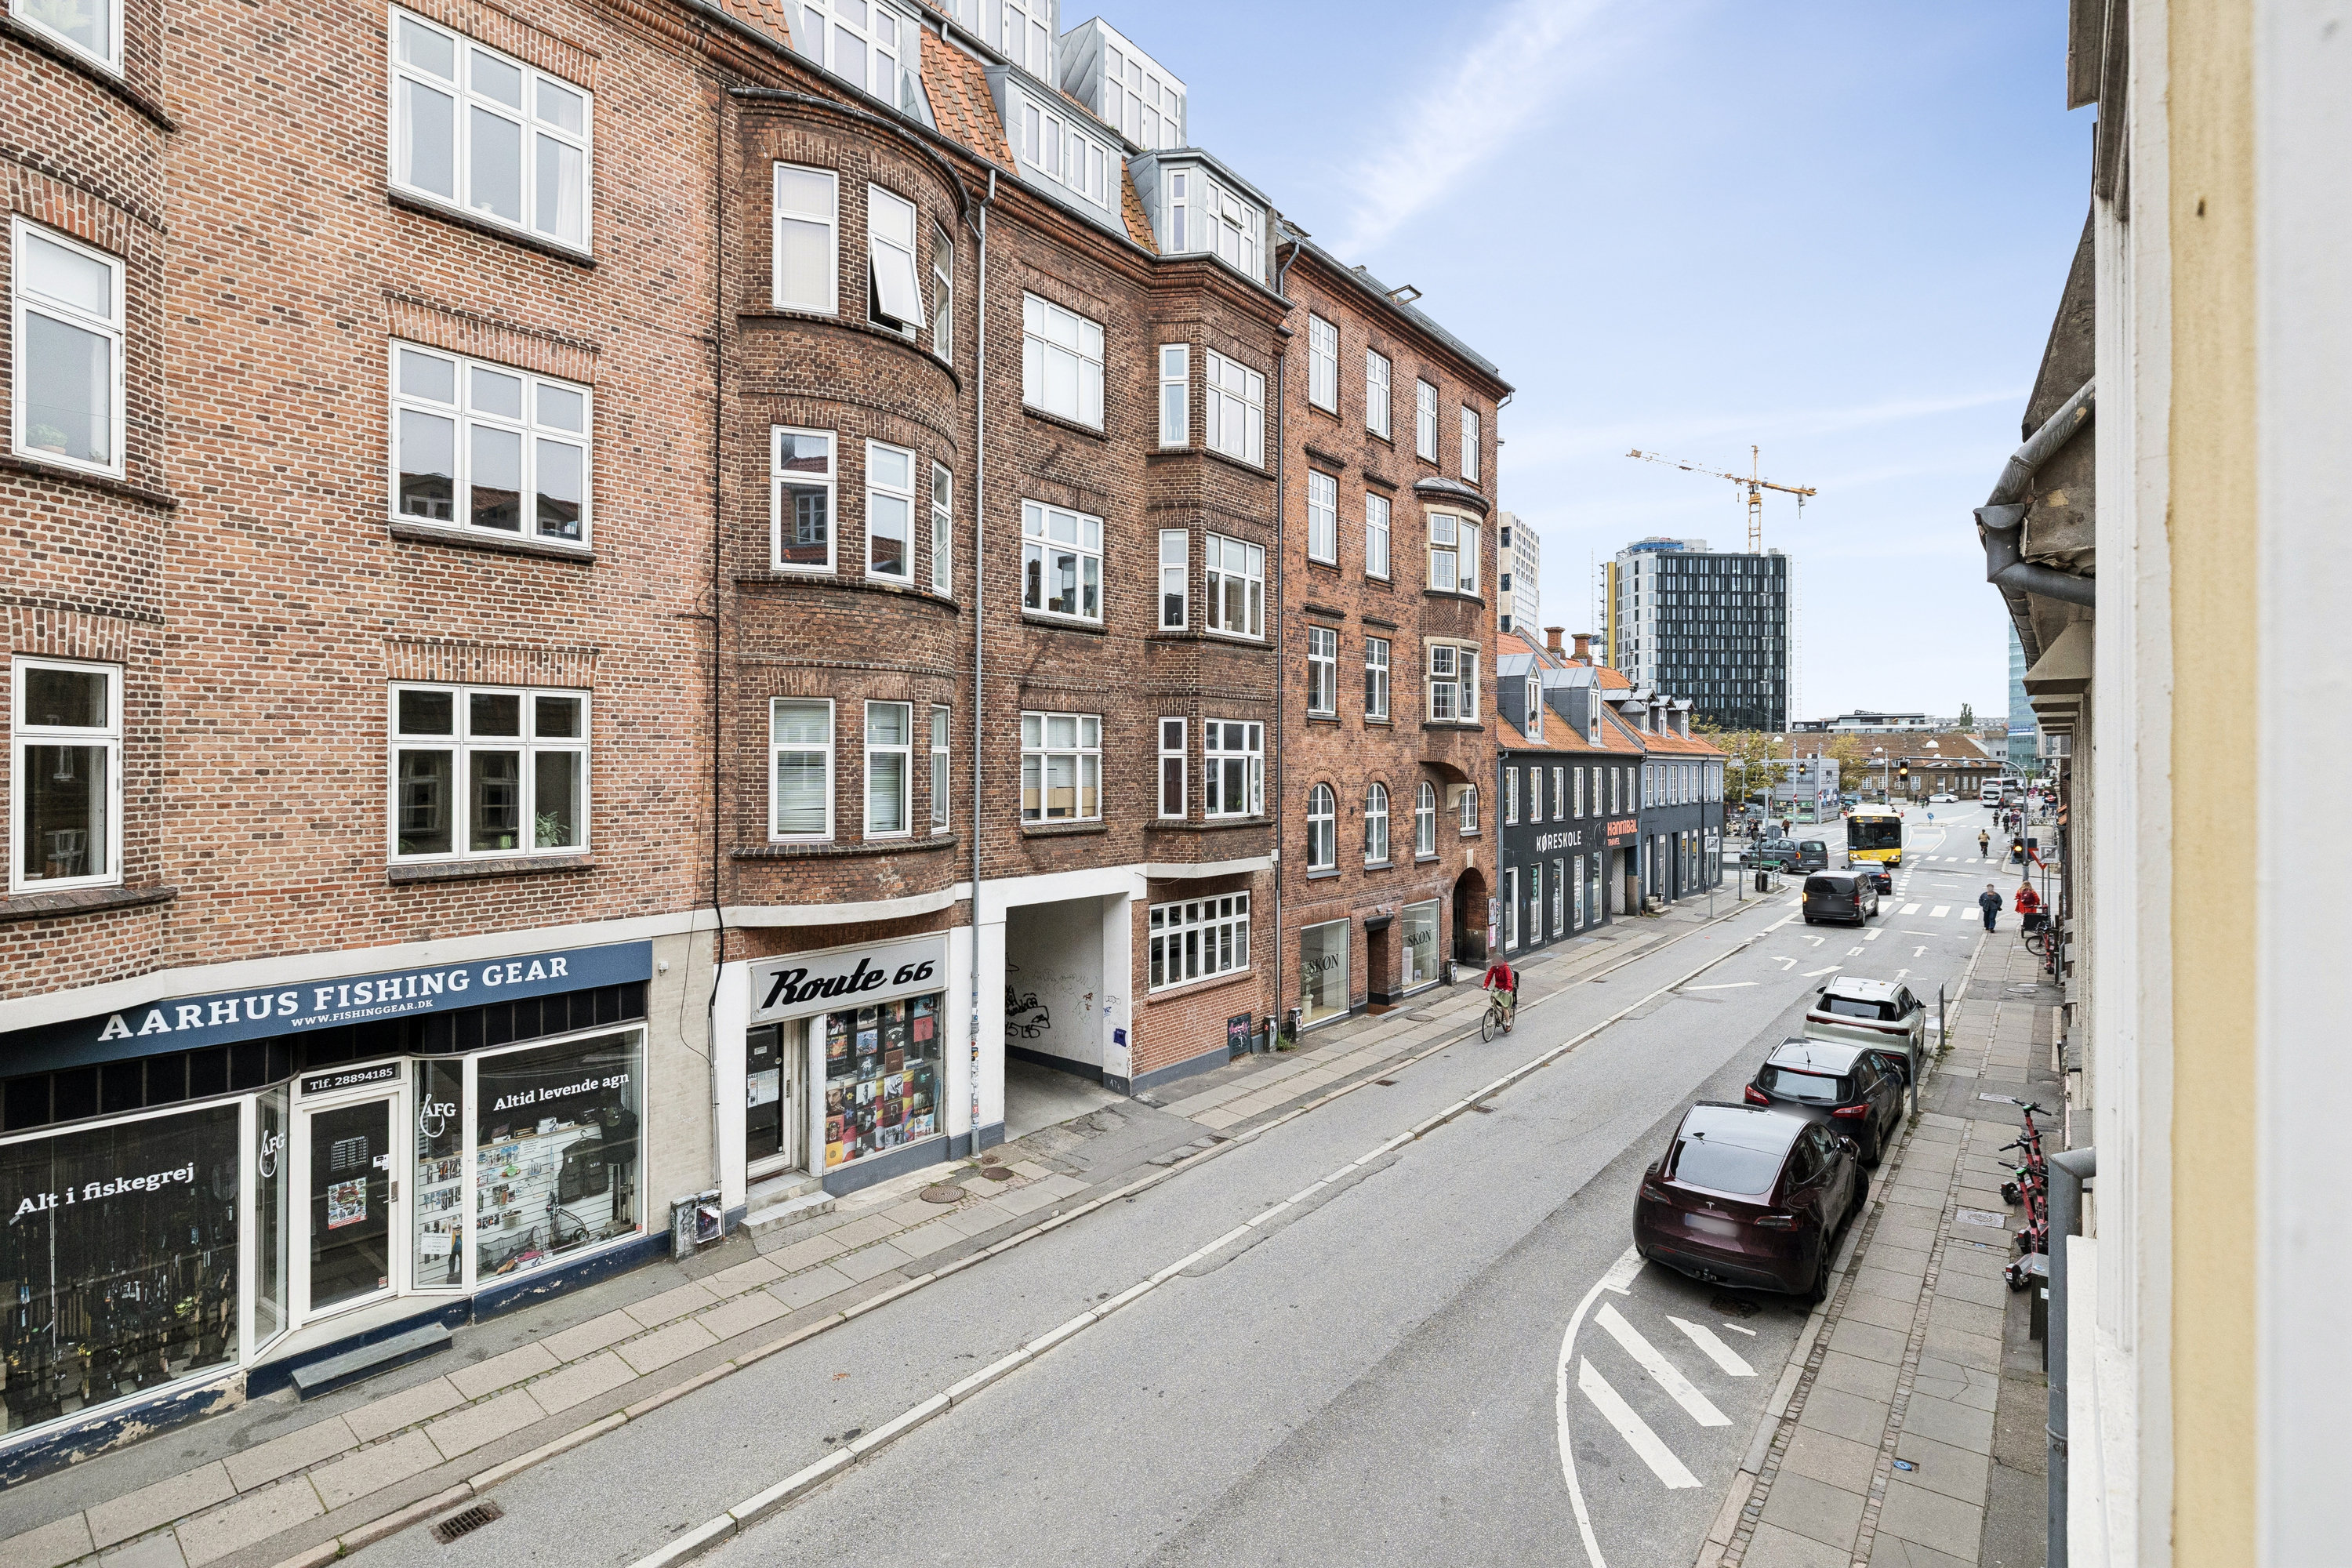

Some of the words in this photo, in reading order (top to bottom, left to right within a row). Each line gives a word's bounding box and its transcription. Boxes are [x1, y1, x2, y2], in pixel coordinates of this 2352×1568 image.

[1536, 830, 1582, 853] KØRESKOLE
[1407, 929, 1431, 947] SKØN
[1309, 954, 1339, 974] SKØN
[761, 957, 887, 1009] Route
[892, 960, 936, 985] 66
[97, 991, 299, 1042] AARHUS
[314, 970, 470, 1011] FISHING
[482, 957, 568, 987] GEAR
[292, 1000, 434, 1027] WWW.FISHINGGEAR.DK
[310, 1078, 332, 1091] Tlf.
[335, 1068, 393, 1086] 28894185
[493, 1091, 535, 1111] Altid
[539, 1079, 599, 1102] levende
[602, 1073, 630, 1089] agn
[425, 1103, 456, 1117] AFG
[263, 1133, 285, 1156] AFG
[15, 1192, 59, 1216] Alt
[66, 1187, 75, 1205] i
[82, 1162, 194, 1201] fiskegrej
